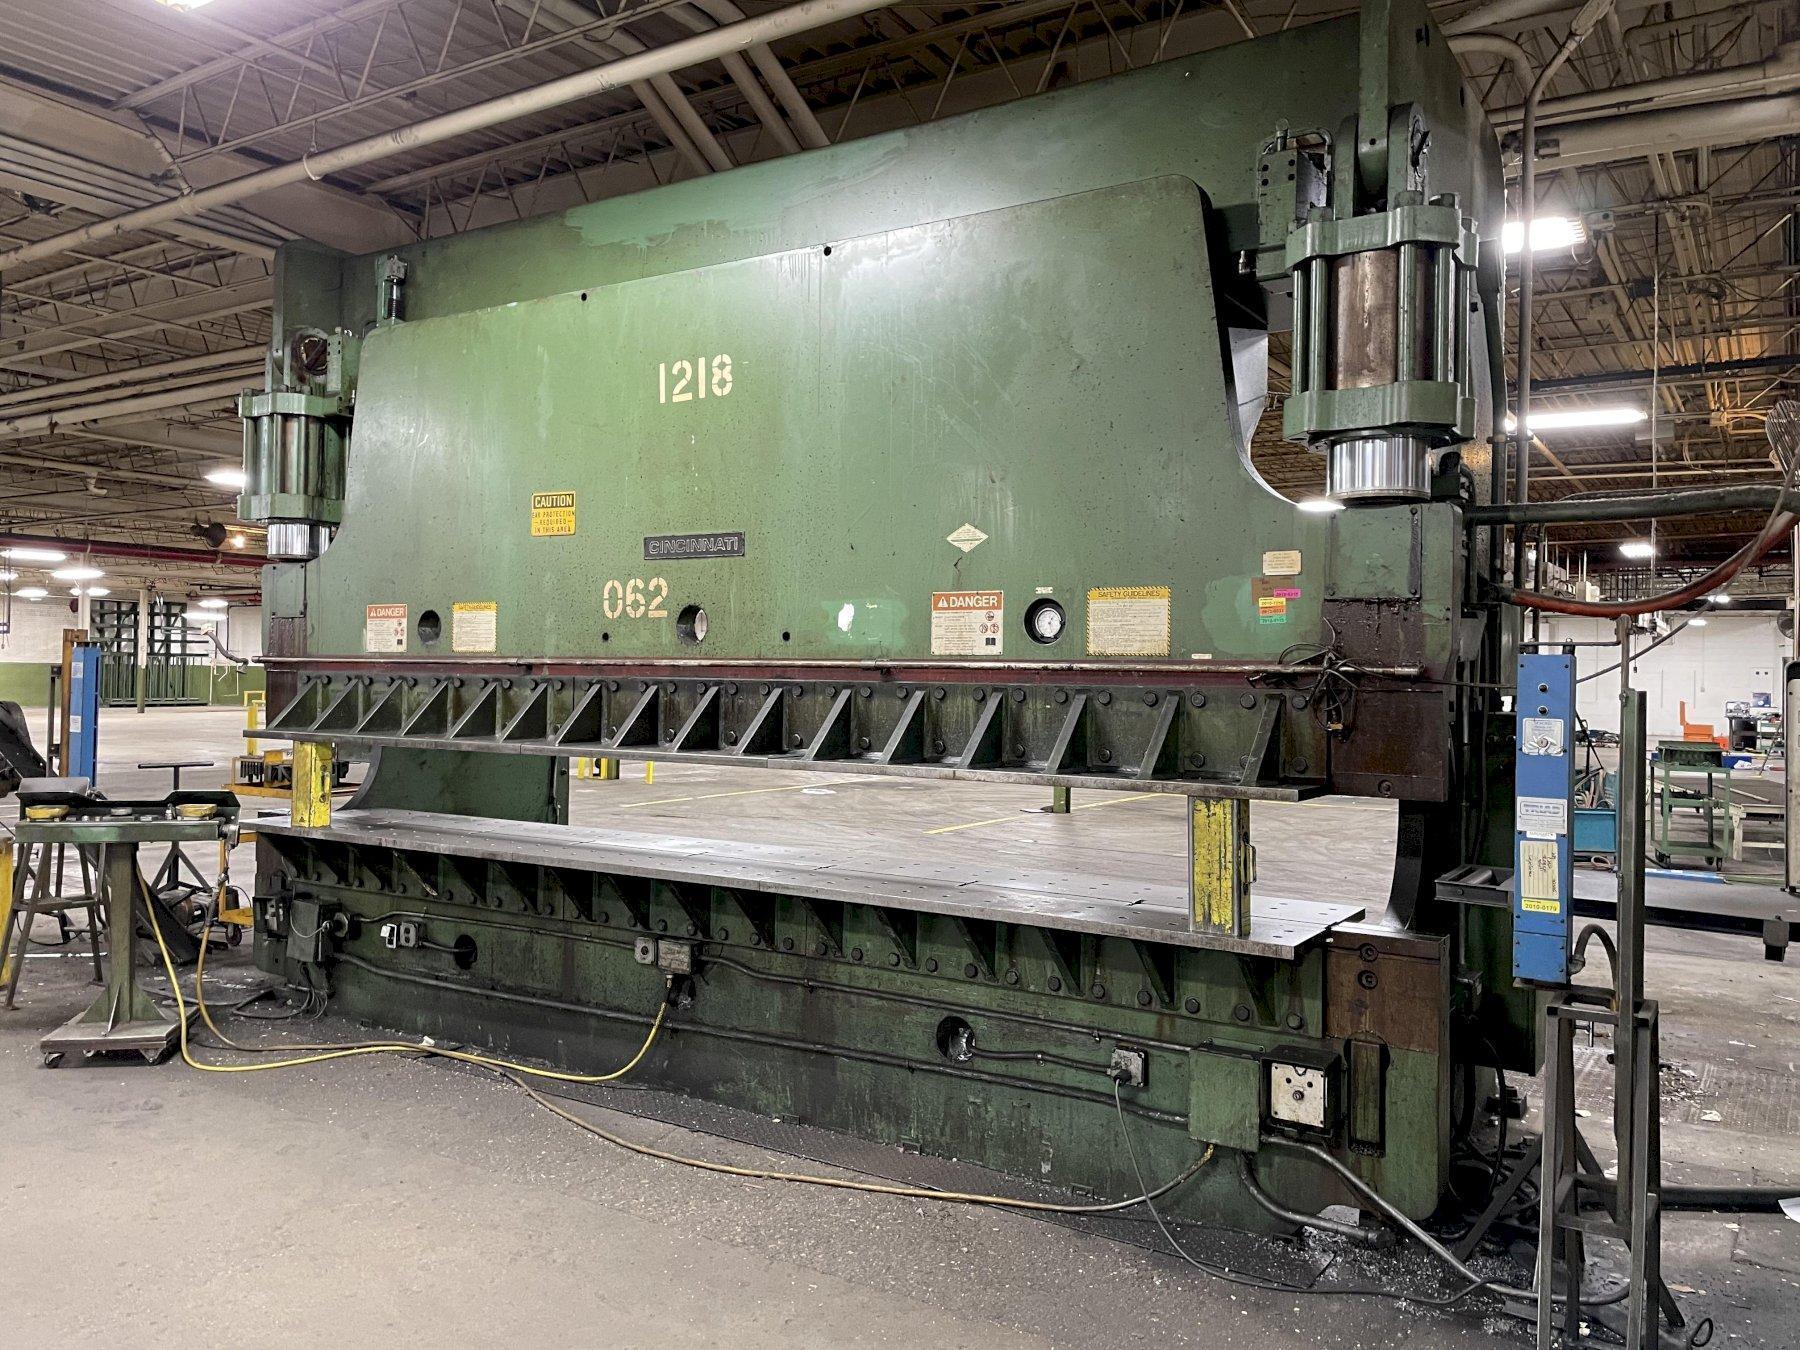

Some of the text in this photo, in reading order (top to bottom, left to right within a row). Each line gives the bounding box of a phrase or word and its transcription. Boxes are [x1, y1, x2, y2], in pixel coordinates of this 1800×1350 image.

[659, 353, 733, 404] 1218
[535, 494, 573, 508] CAUTION
[543, 510, 575, 518] PROTECTION
[649, 536, 738, 554] CINCINNATI
[603, 577, 668, 619] 062
[1098, 590, 1121, 598] SAFETY
[949, 595, 998, 608] DANGER
[377, 607, 405, 617] DANGER
